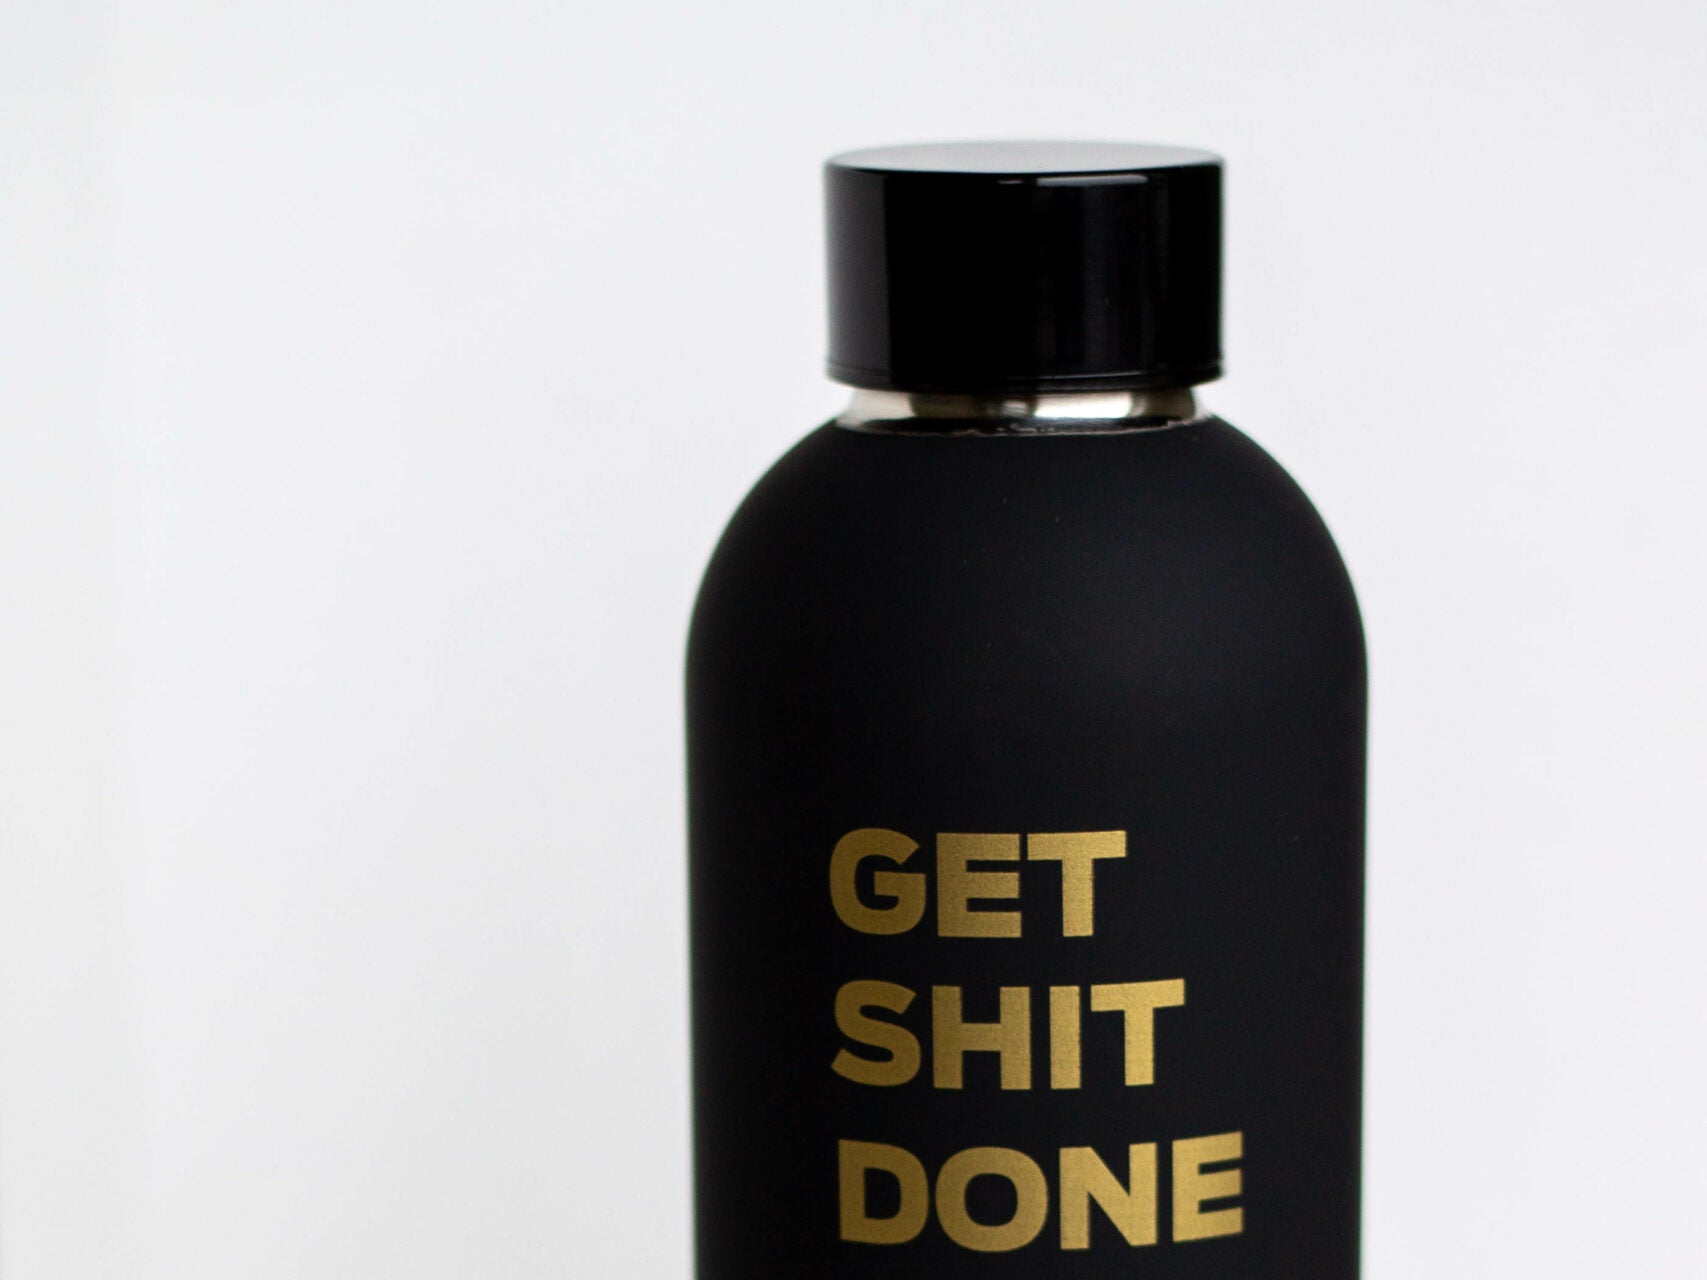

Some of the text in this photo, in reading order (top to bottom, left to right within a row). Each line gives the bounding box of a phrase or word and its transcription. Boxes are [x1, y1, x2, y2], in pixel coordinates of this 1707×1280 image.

[829, 828, 1127, 938] GET
[831, 978, 1186, 1090] SHIT
[838, 1131, 1244, 1252] DONE
